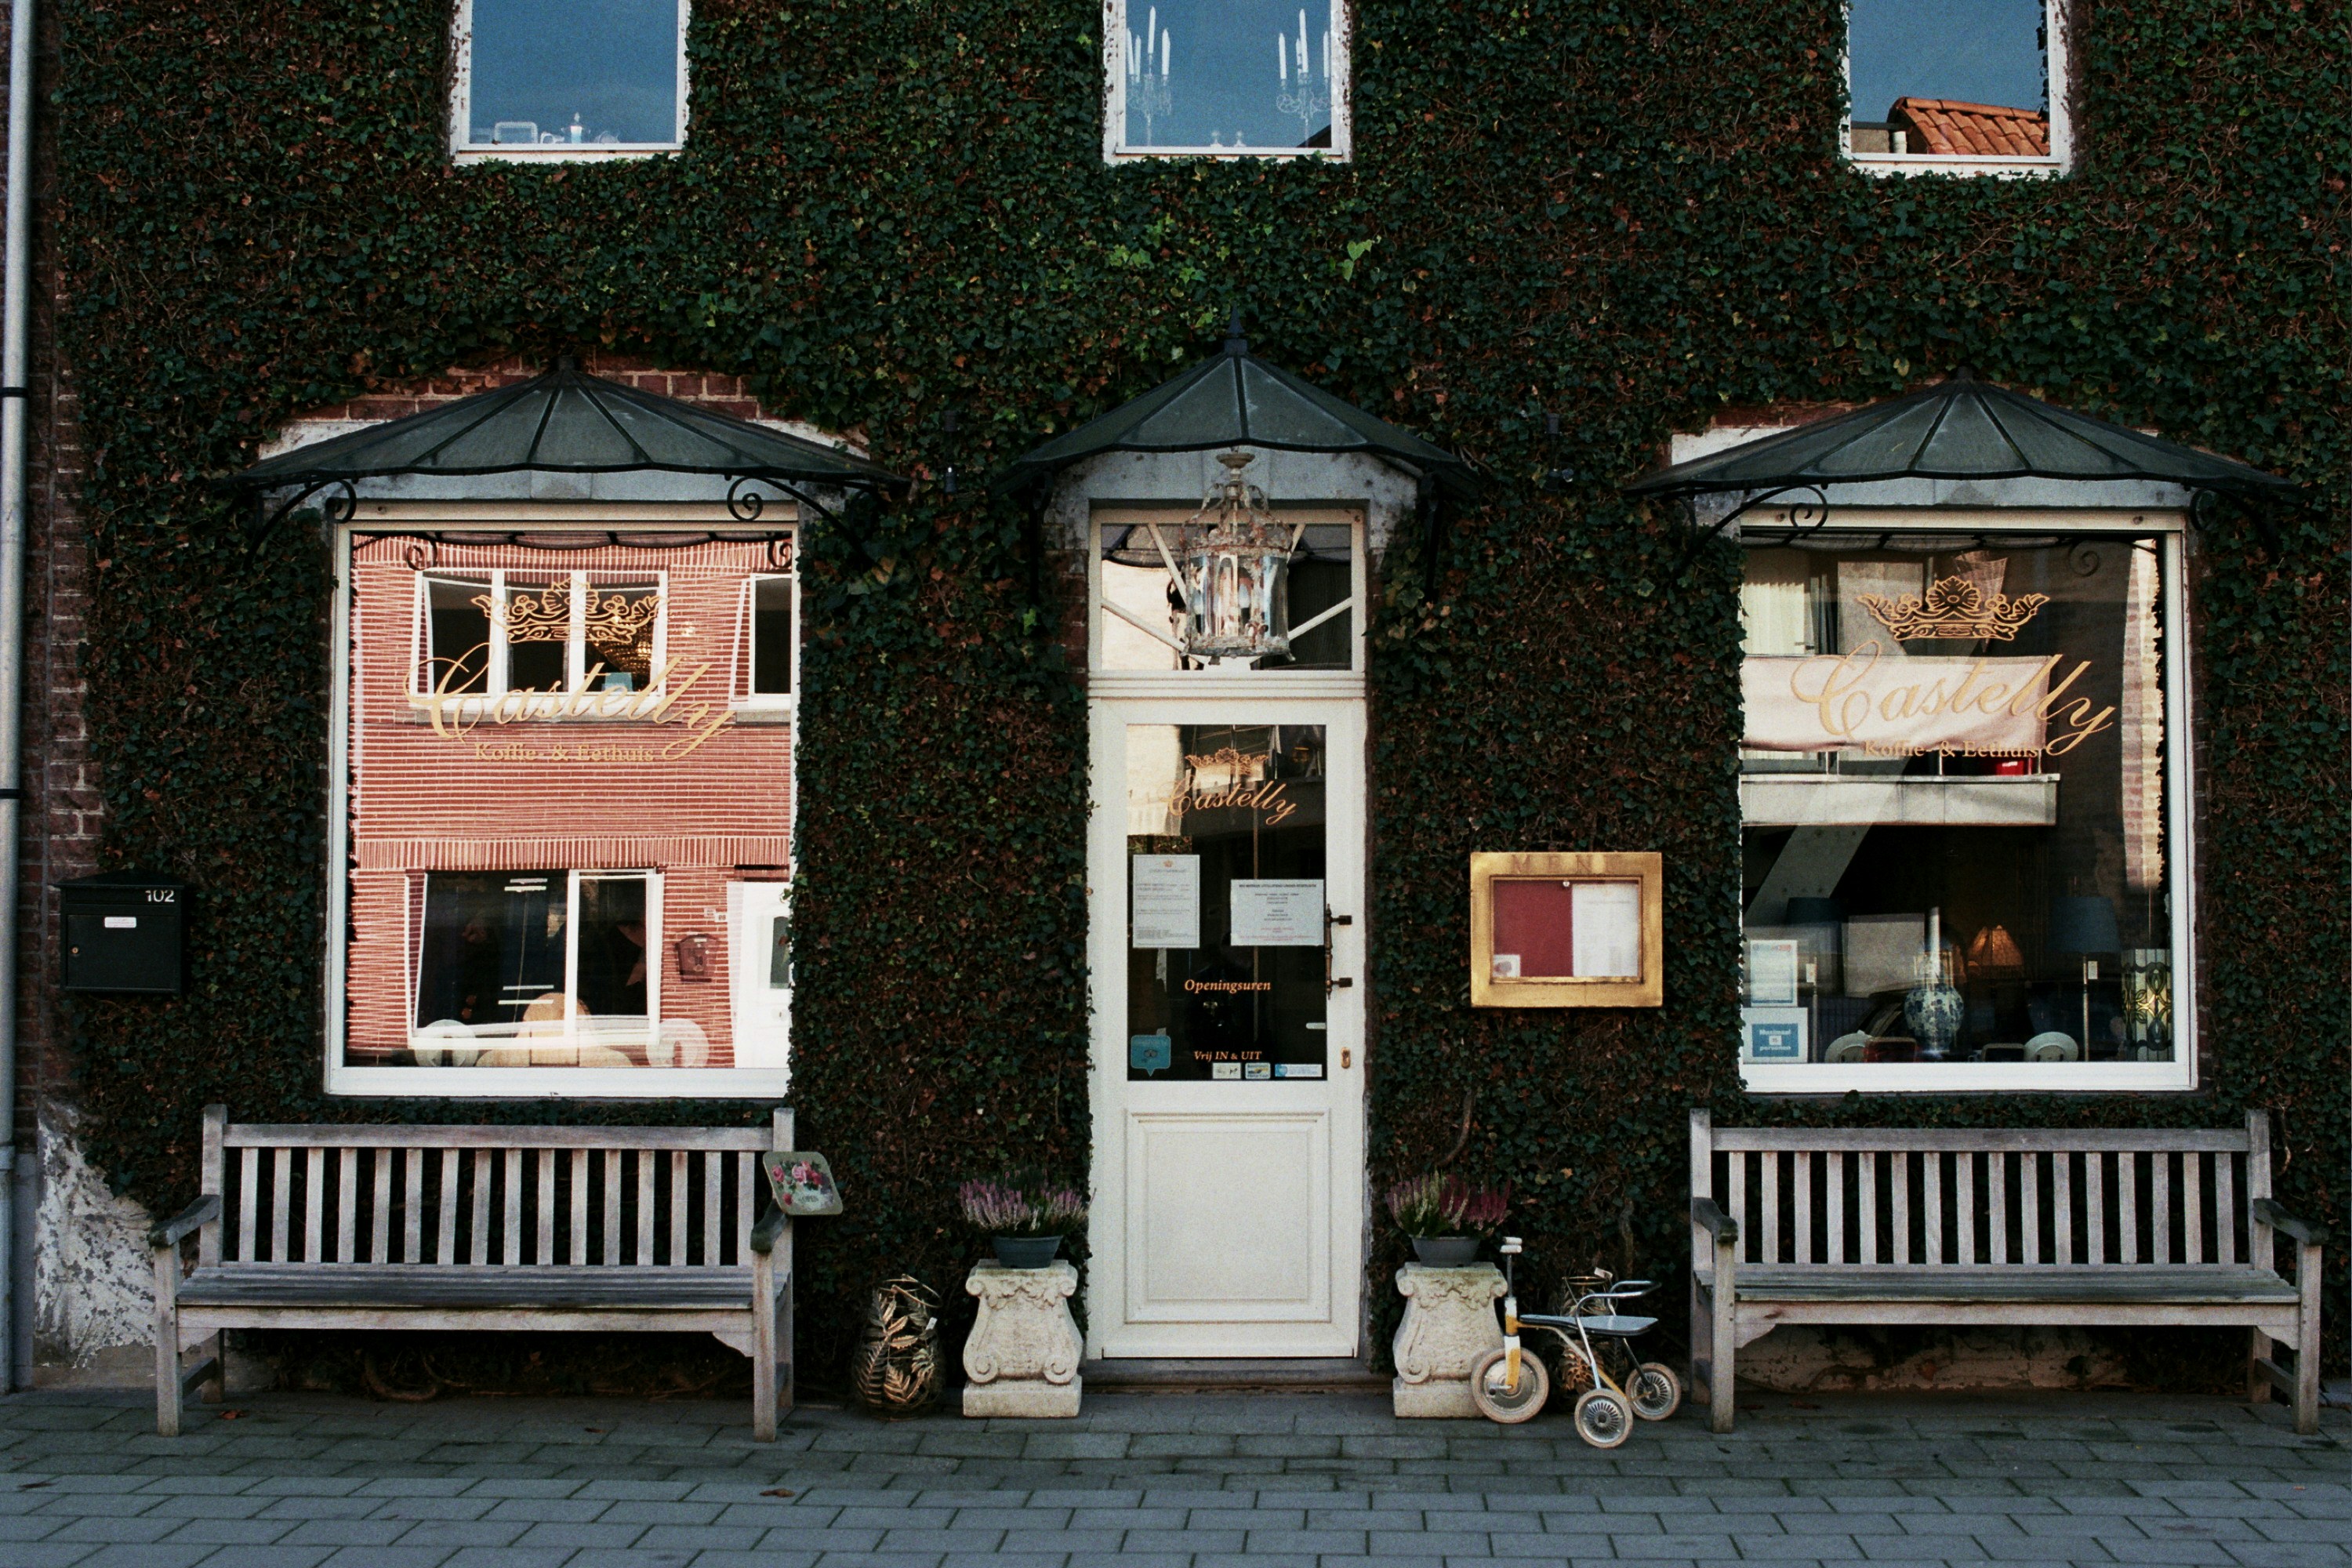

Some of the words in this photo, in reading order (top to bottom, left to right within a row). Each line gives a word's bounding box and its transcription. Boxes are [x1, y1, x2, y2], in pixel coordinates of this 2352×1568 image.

[402, 642, 738, 760] Castelly
[1790, 640, 2117, 757] Castelly
[474, 742, 543, 761] Koffie-
[551, 744, 570, 761] &
[578, 743, 655, 762] Eethuis
[1863, 740, 1932, 758] Koffie-
[1940, 740, 1956, 758] &
[1962, 740, 2038, 759] Eethuis
[1159, 775, 1298, 826] Castelly
[145, 889, 175, 902] 102
[1184, 979, 1272, 994] Openingsuren
[1194, 1051, 1213, 1062] Vrij
[1215, 1051, 1229, 1060] IN
[1241, 1051, 1261, 1060] UIT
